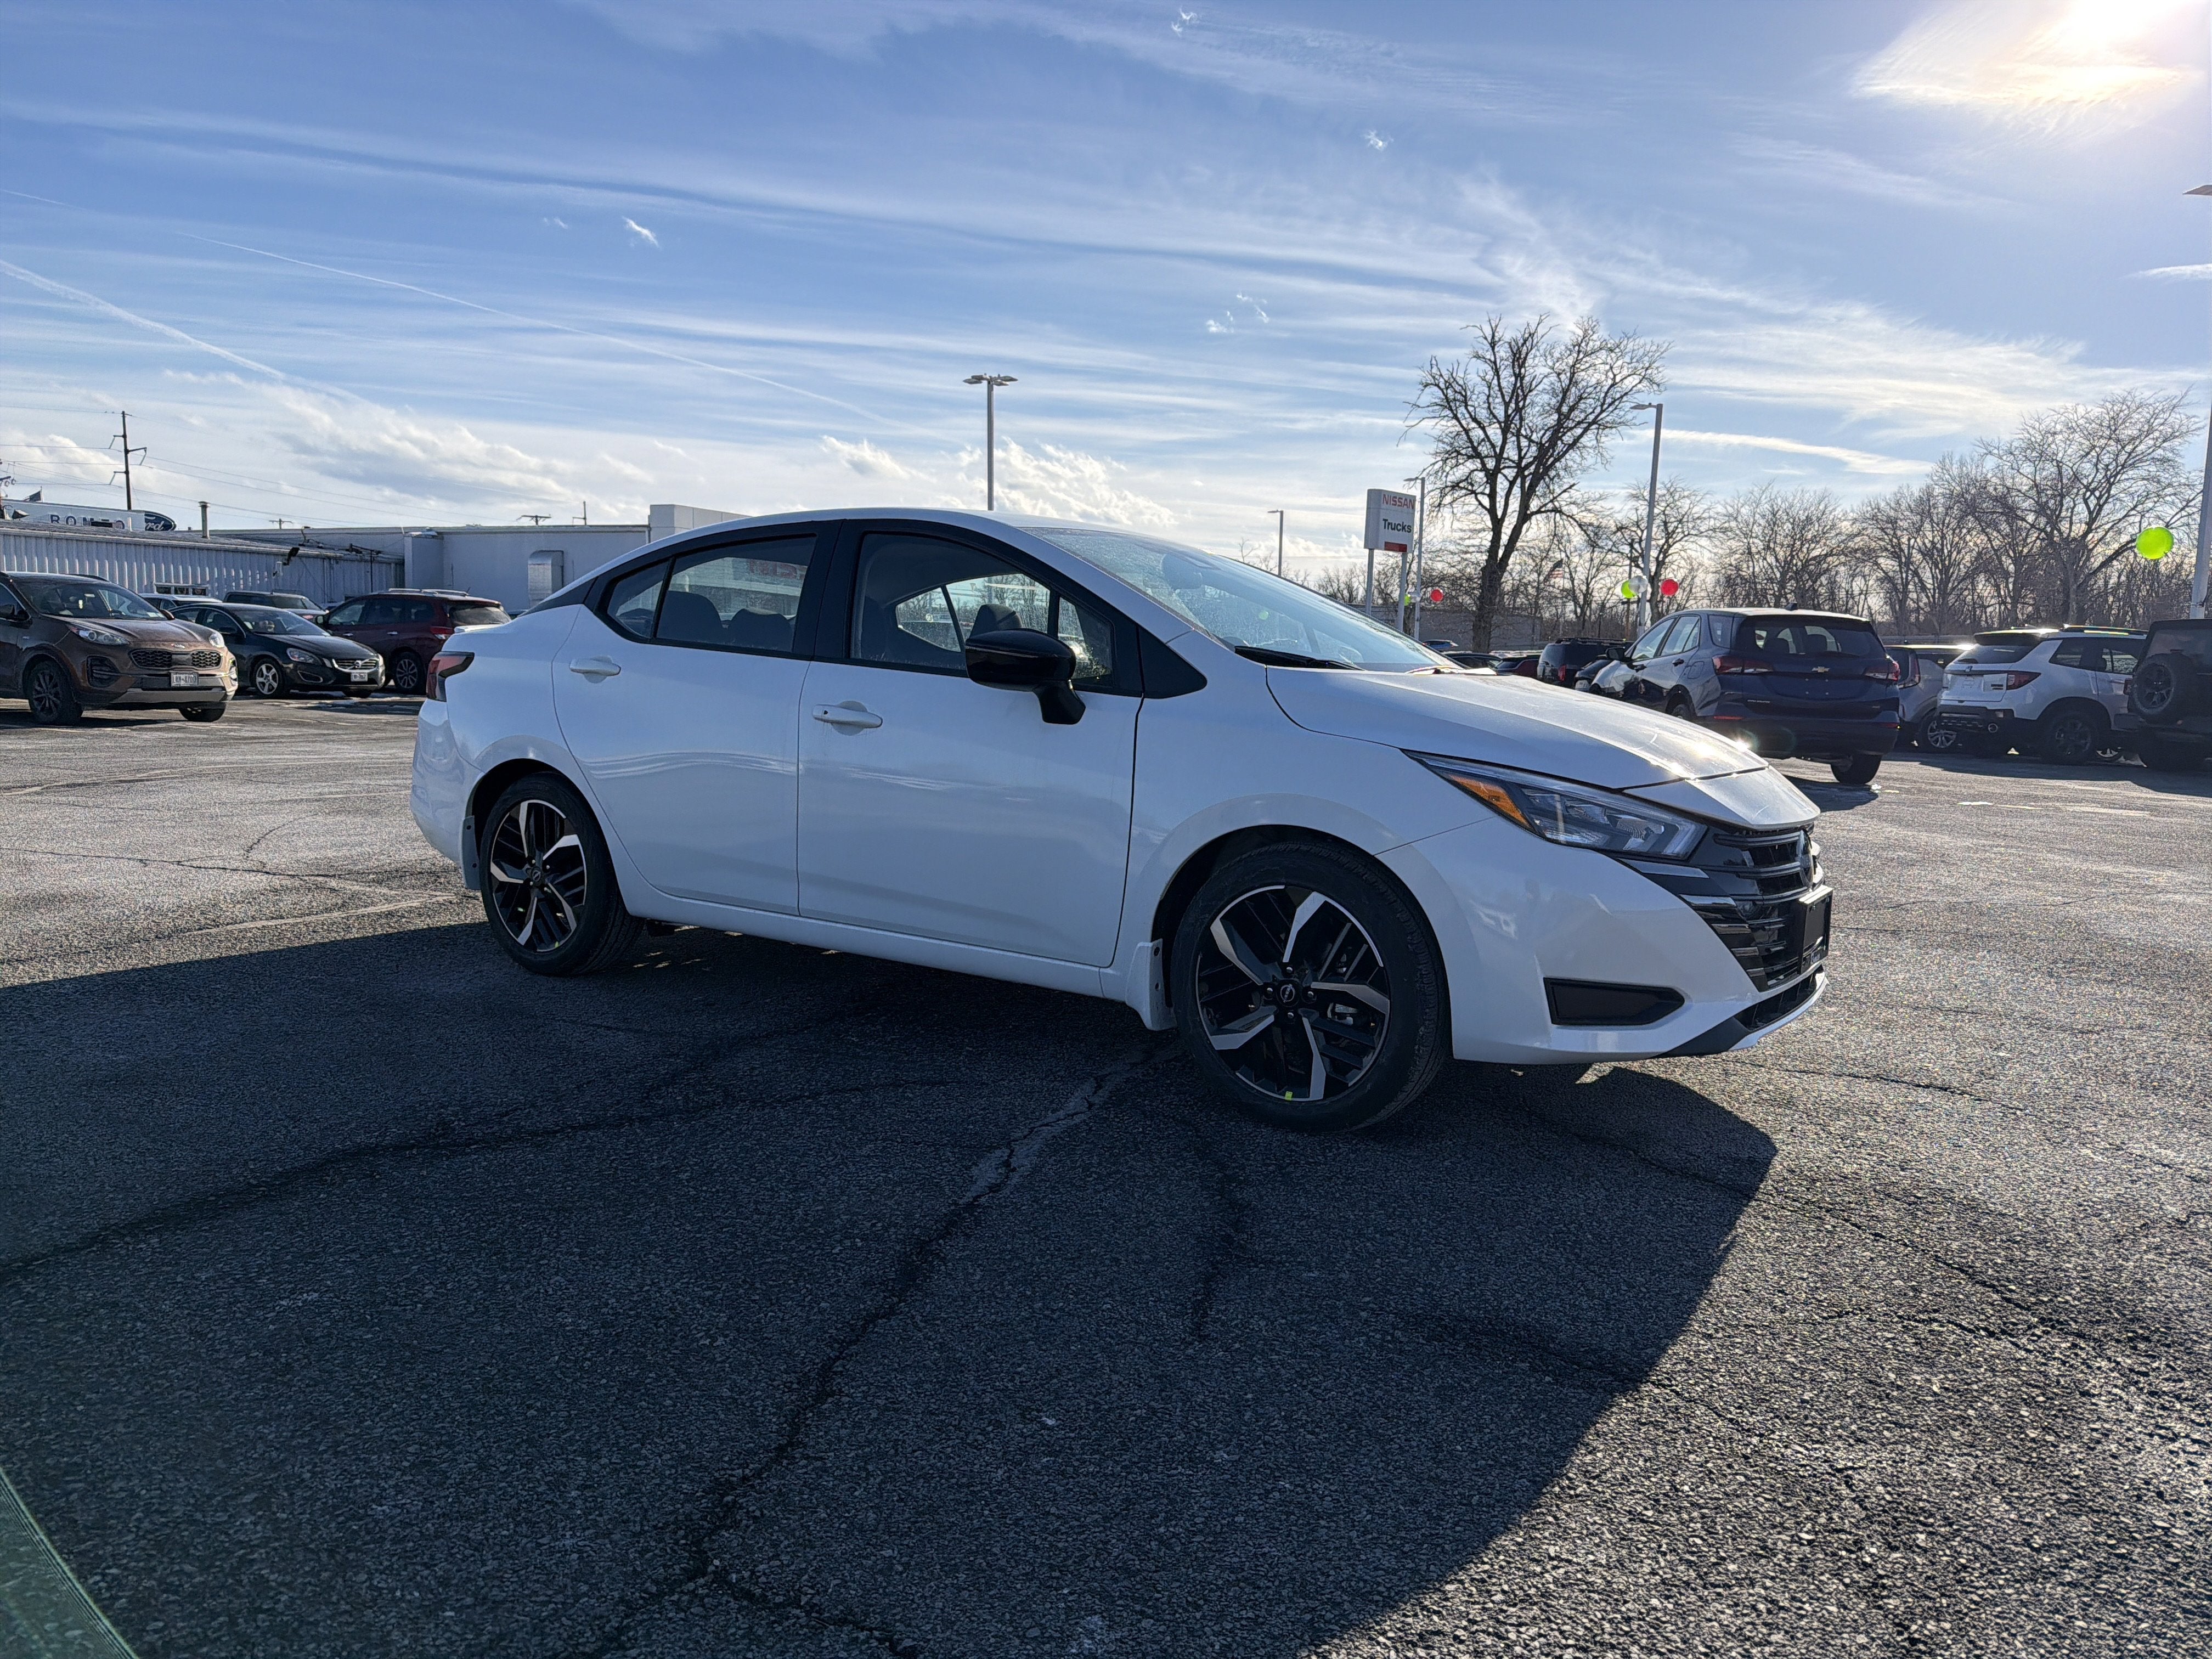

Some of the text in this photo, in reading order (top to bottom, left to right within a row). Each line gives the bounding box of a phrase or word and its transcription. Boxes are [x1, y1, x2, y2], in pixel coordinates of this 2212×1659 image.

[1383, 494, 1414, 509] NISSAN
[50, 515, 125, 529] ROMO
[145, 515, 164, 531] rd
[1383, 518, 1412, 533] Trucks
